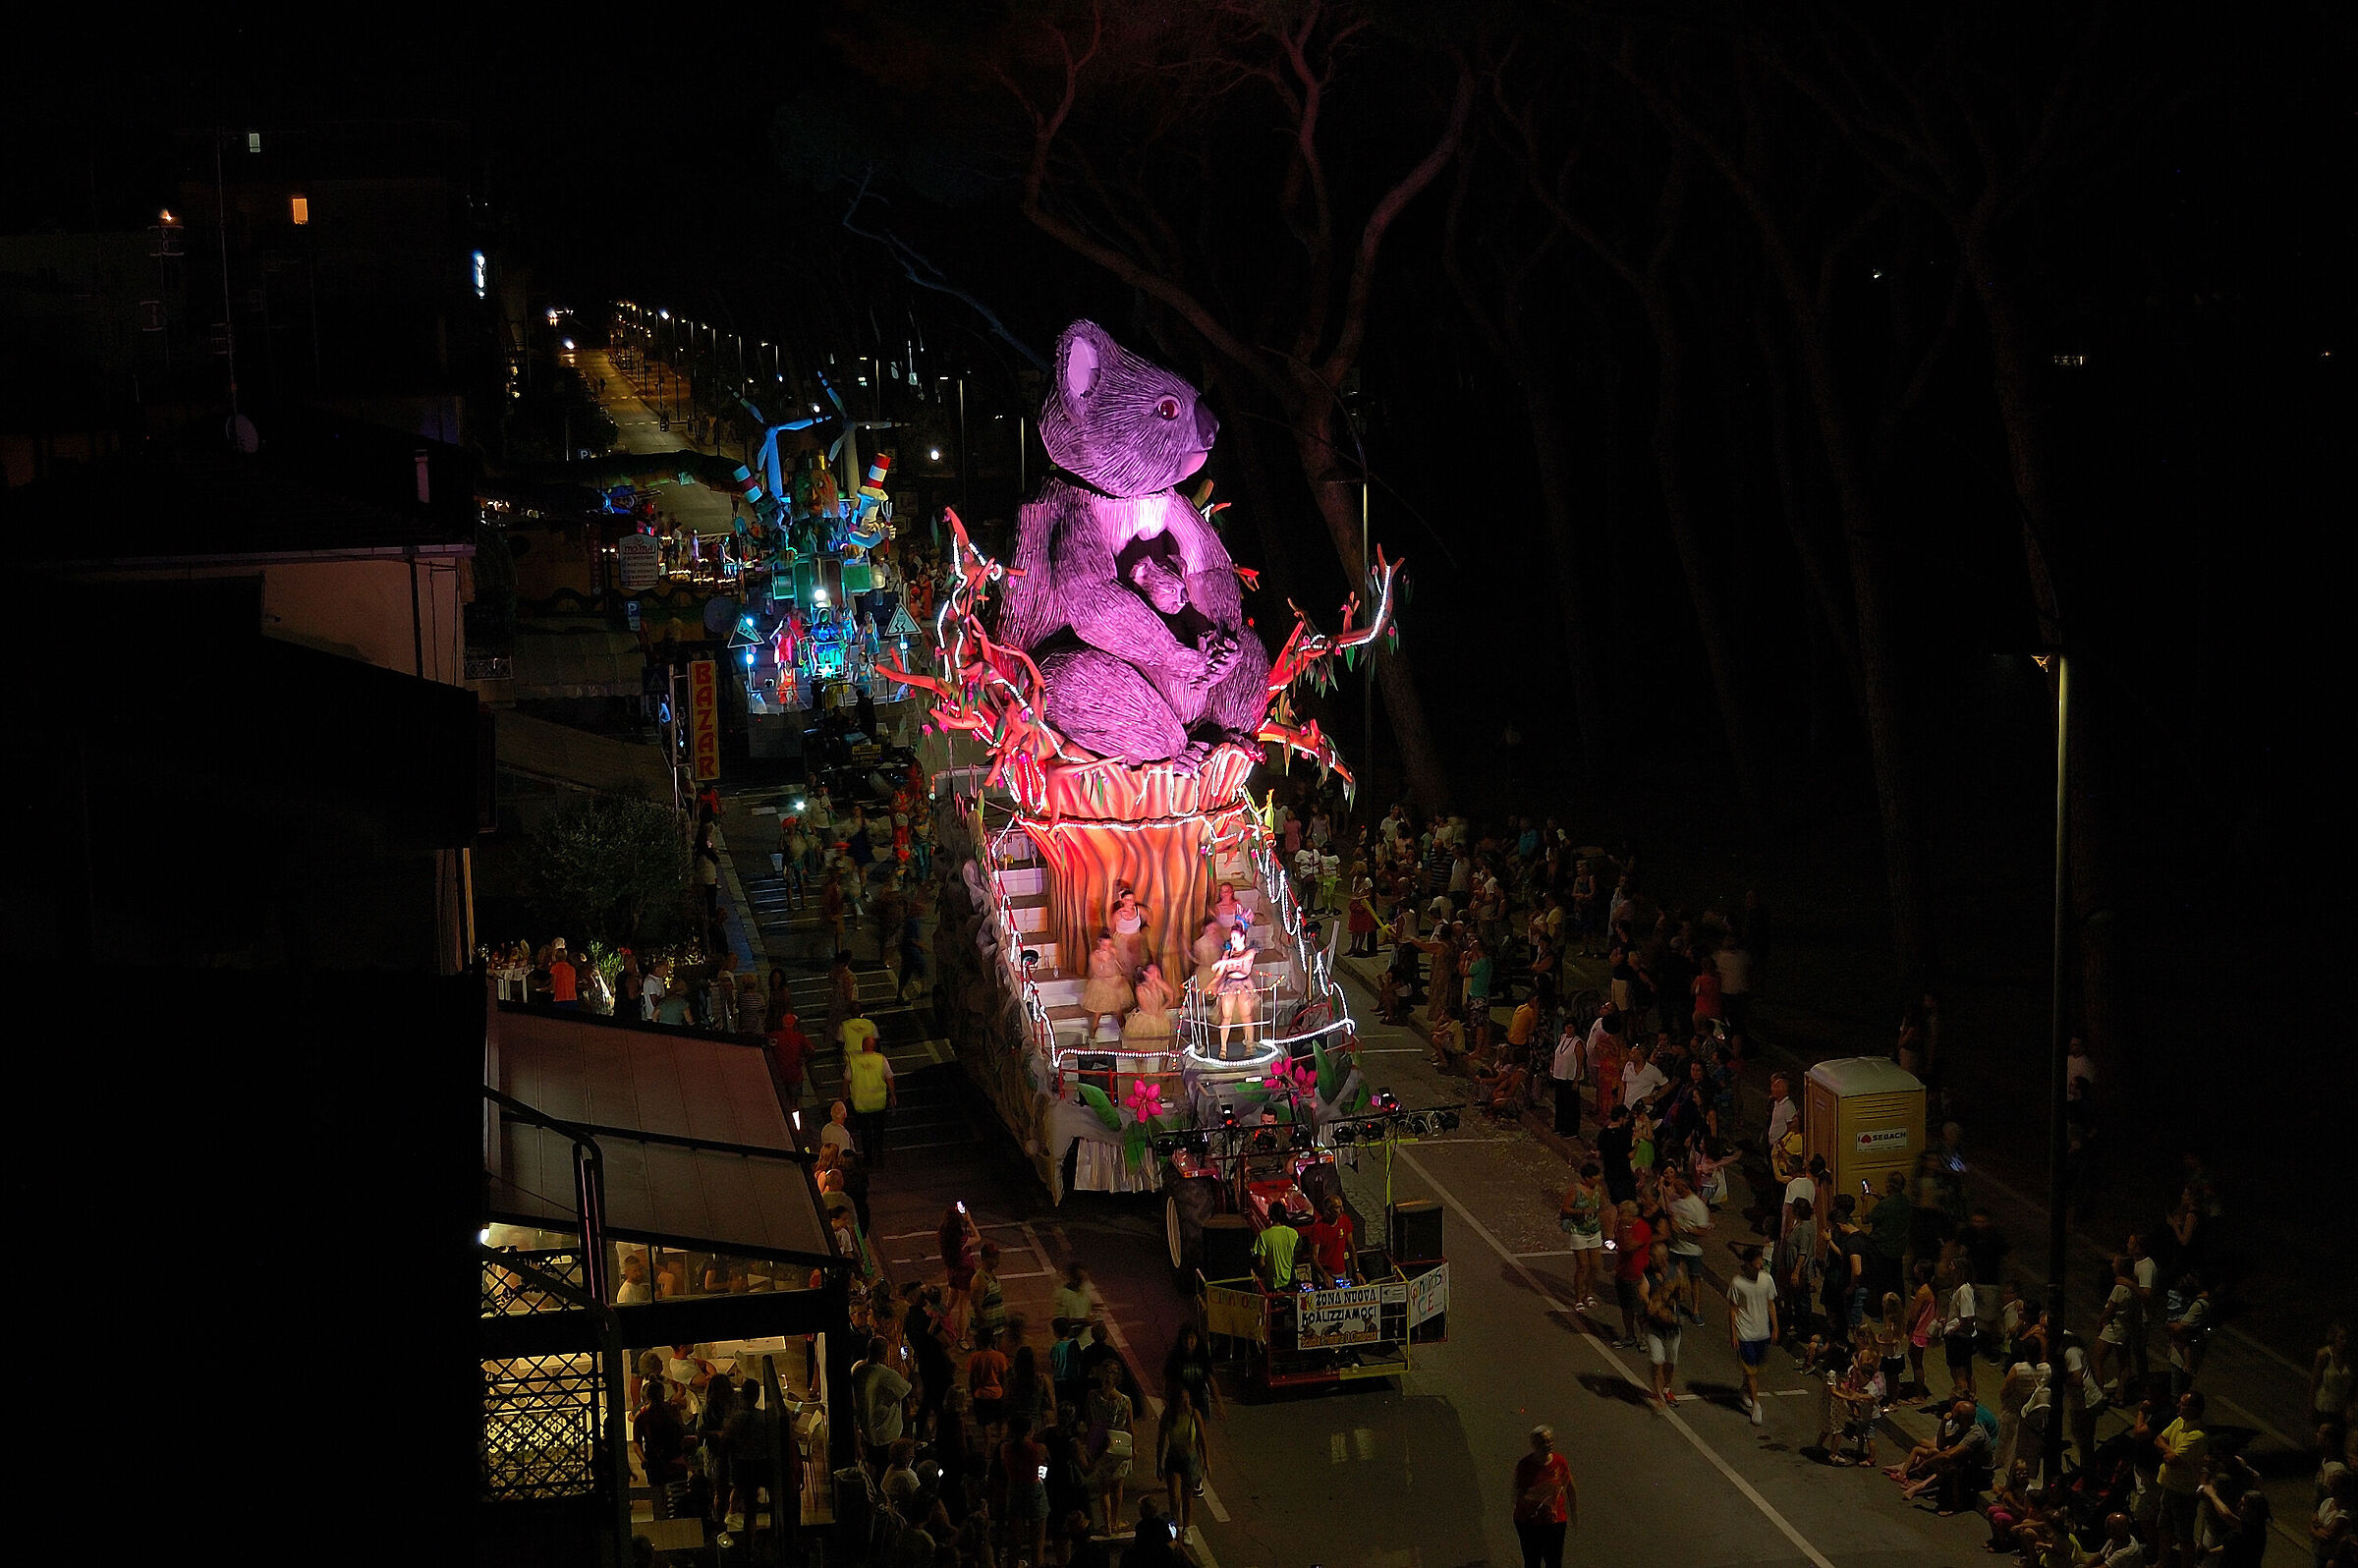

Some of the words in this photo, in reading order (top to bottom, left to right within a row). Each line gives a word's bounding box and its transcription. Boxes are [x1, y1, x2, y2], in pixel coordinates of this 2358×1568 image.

[695, 662, 715, 778] BAZAR
[1316, 1292, 1341, 1306] ZONA
[1344, 1288, 1376, 1304] NUOVA
[1301, 1306, 1376, 1327] KOALIZZIAMOCI
